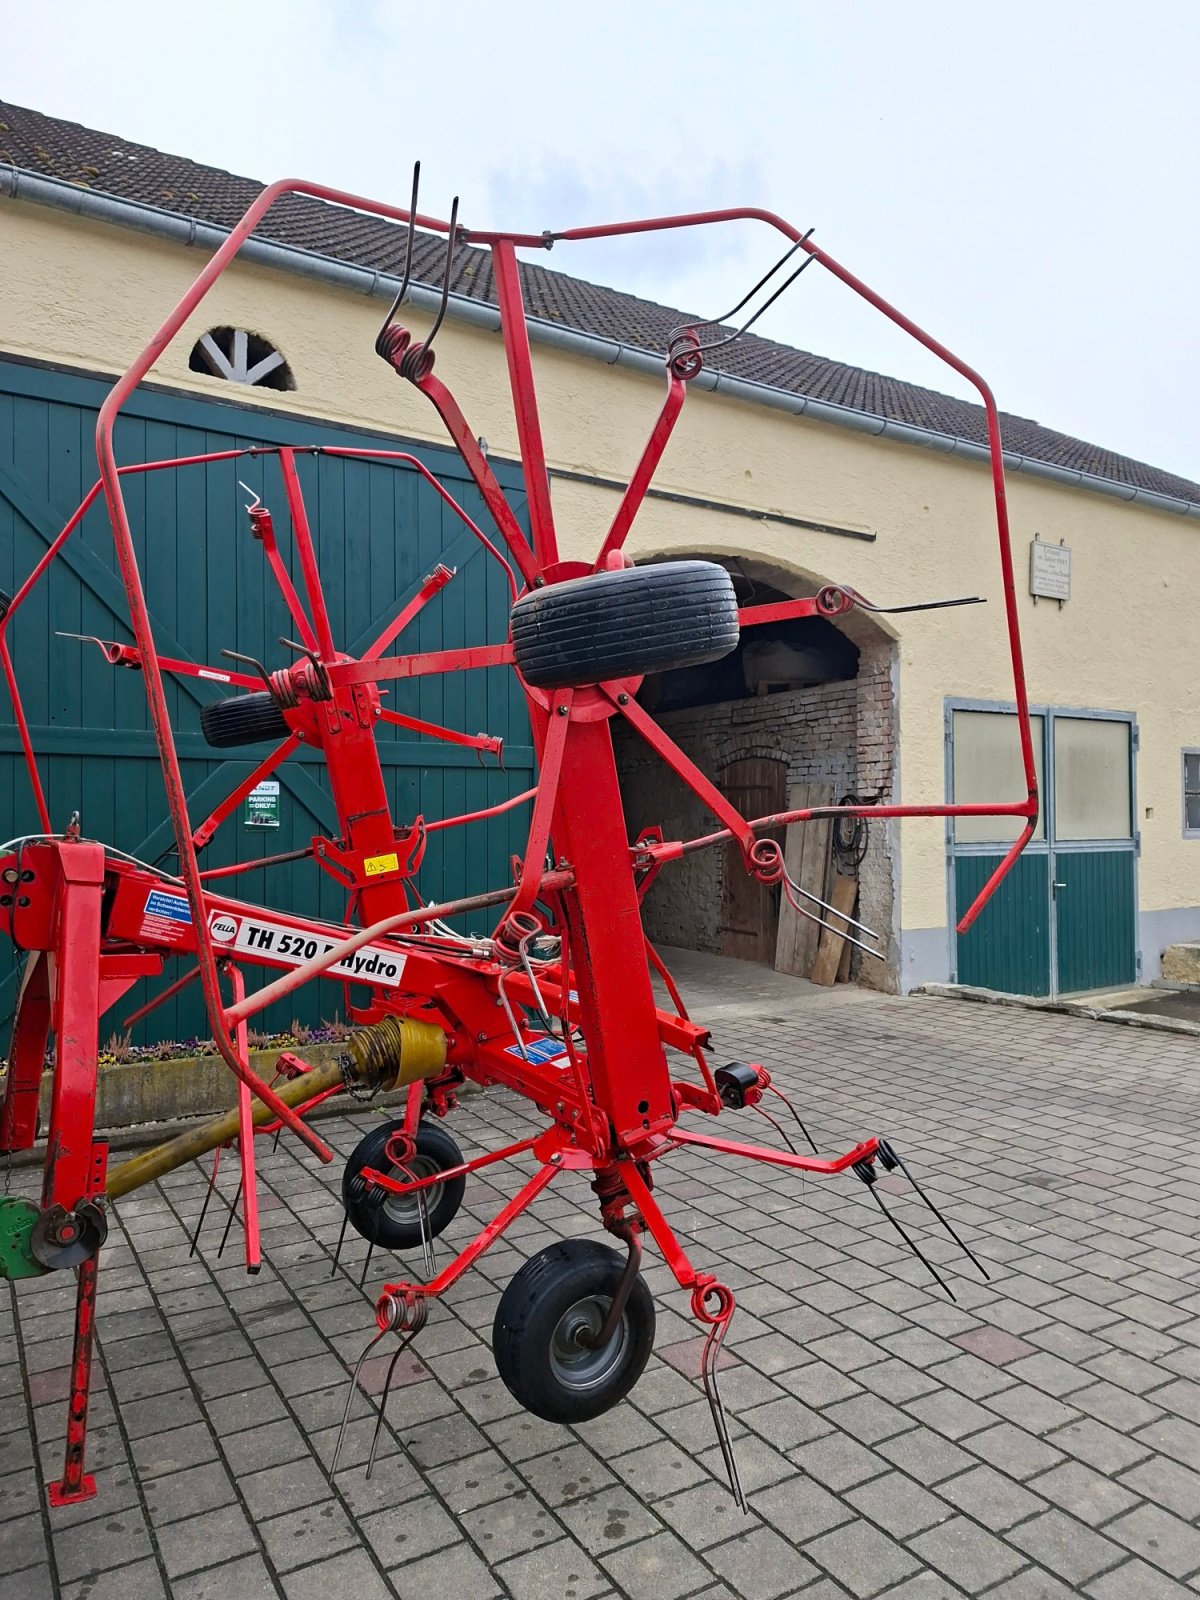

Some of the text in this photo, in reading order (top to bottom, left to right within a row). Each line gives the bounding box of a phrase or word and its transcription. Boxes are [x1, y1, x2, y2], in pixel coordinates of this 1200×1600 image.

[148, 907, 173, 915] verboten!
[212, 922, 235, 934] FELLA
[247, 927, 274, 950] TH
[277, 934, 317, 959] 520
[340, 951, 397, 979] Hydro
